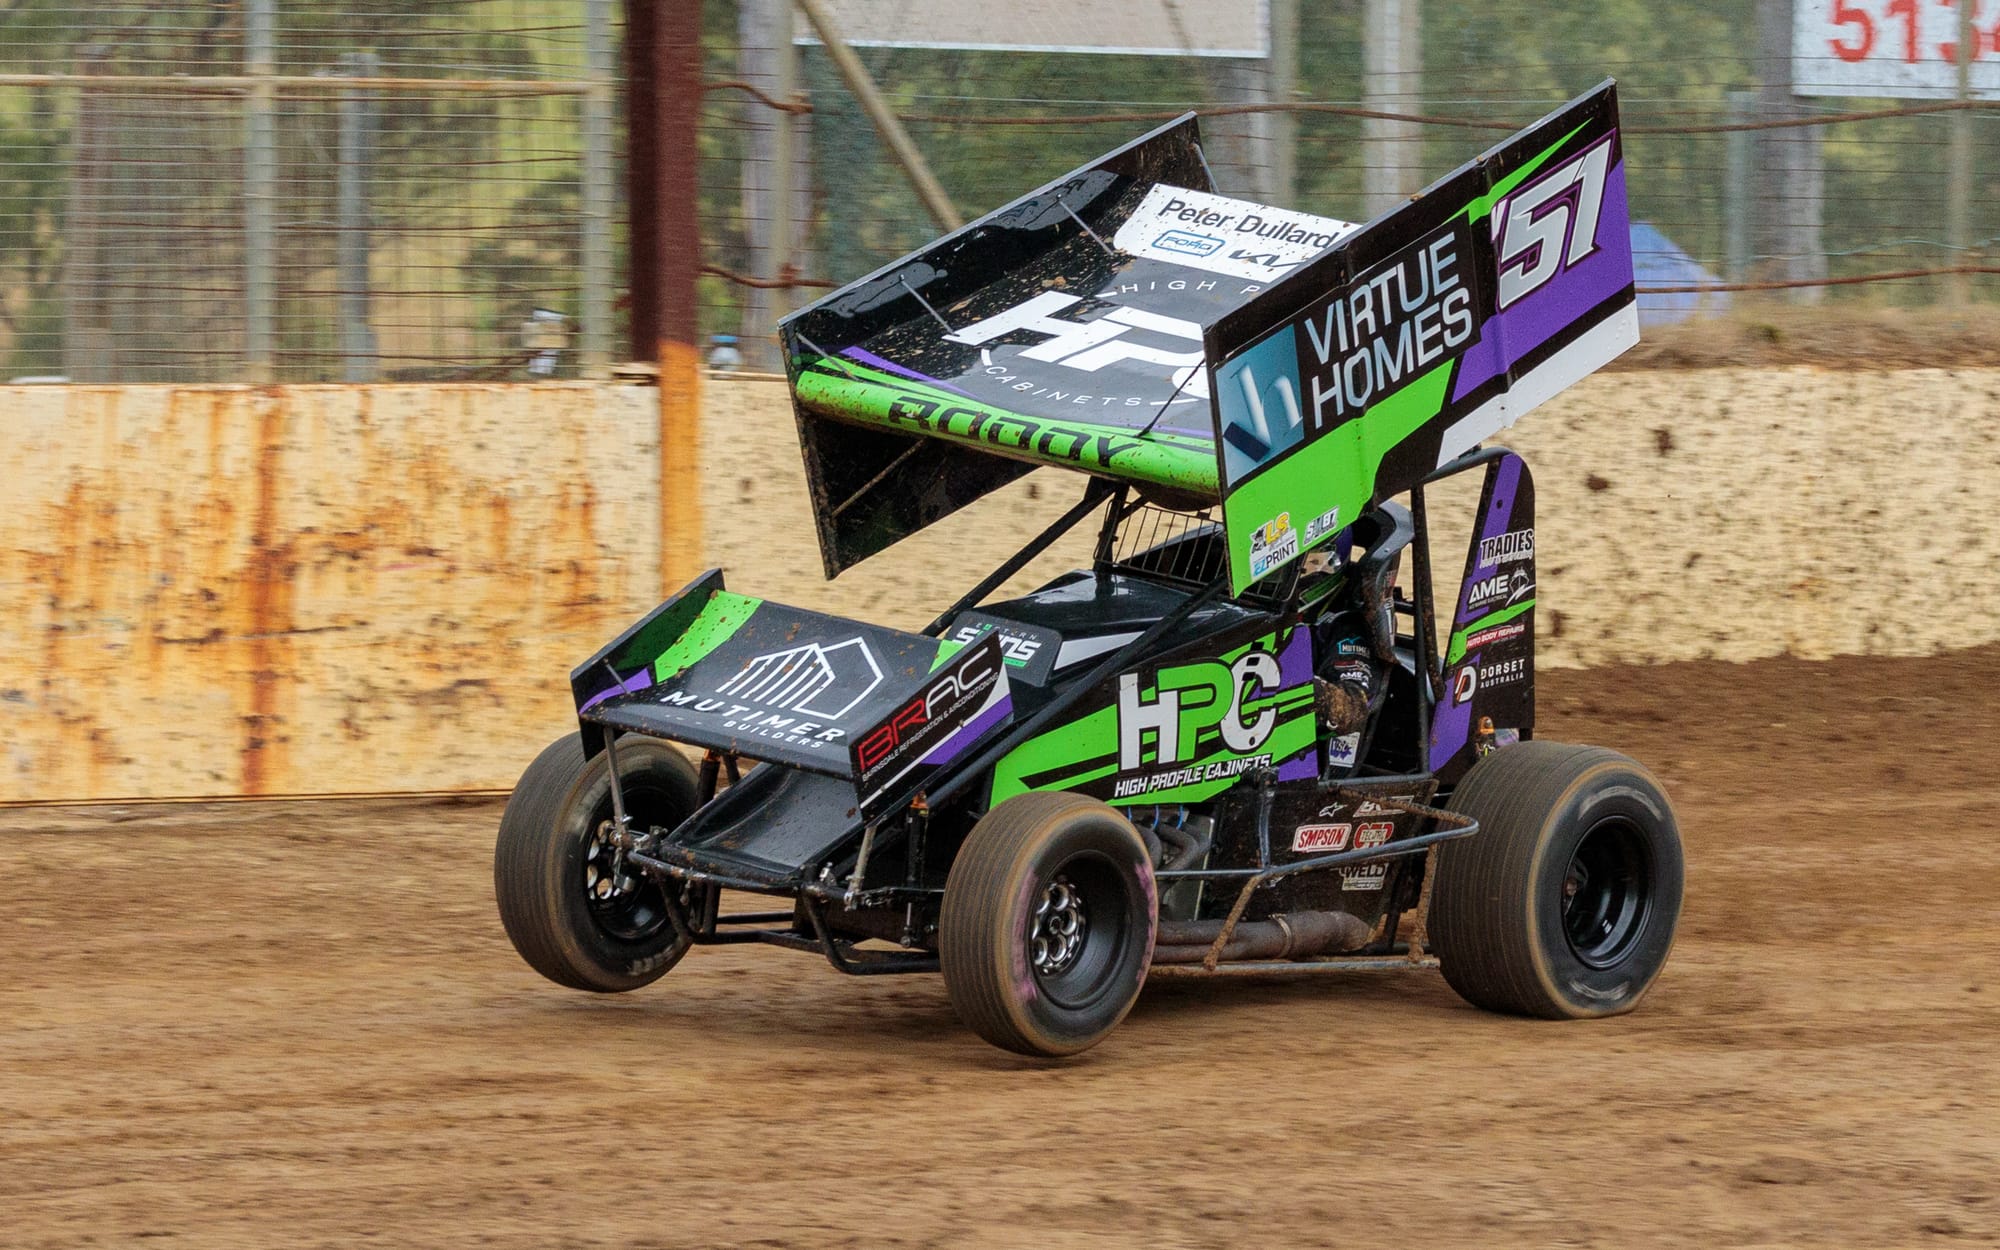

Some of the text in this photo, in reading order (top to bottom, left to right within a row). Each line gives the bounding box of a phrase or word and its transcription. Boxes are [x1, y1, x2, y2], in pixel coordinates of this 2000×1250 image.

[1826, 0, 2000, 64] 513
[1157, 198, 1341, 249] Peter Dullard
[1121, 280, 1217, 294] HIGH
[1305, 231, 1460, 365] VIRTUE
[1311, 286, 1473, 430] HOMES
[985, 366, 1142, 406] CABINETS
[1480, 528, 1534, 561] TRADIES
[1468, 574, 1509, 604] AME
[1480, 658, 1525, 680] DORSET
[1480, 671, 1525, 688] AUSTRALIA
[660, 691, 846, 742] MUTIMER
[858, 647, 992, 773] BRAC
[862, 749, 899, 782] BAIRNSDALE
[899, 715, 944, 753] REFRIGERATION
[949, 671, 999, 715] AIRCONDITIONING
[1119, 652, 1281, 771] HPC
[723, 720, 824, 749] BUILDERS
[1114, 776, 1149, 798] HIGH
[1148, 765, 1203, 791] PROFILE
[1298, 828, 1346, 849] SIMPSON
[1344, 863, 1386, 878] WELD
